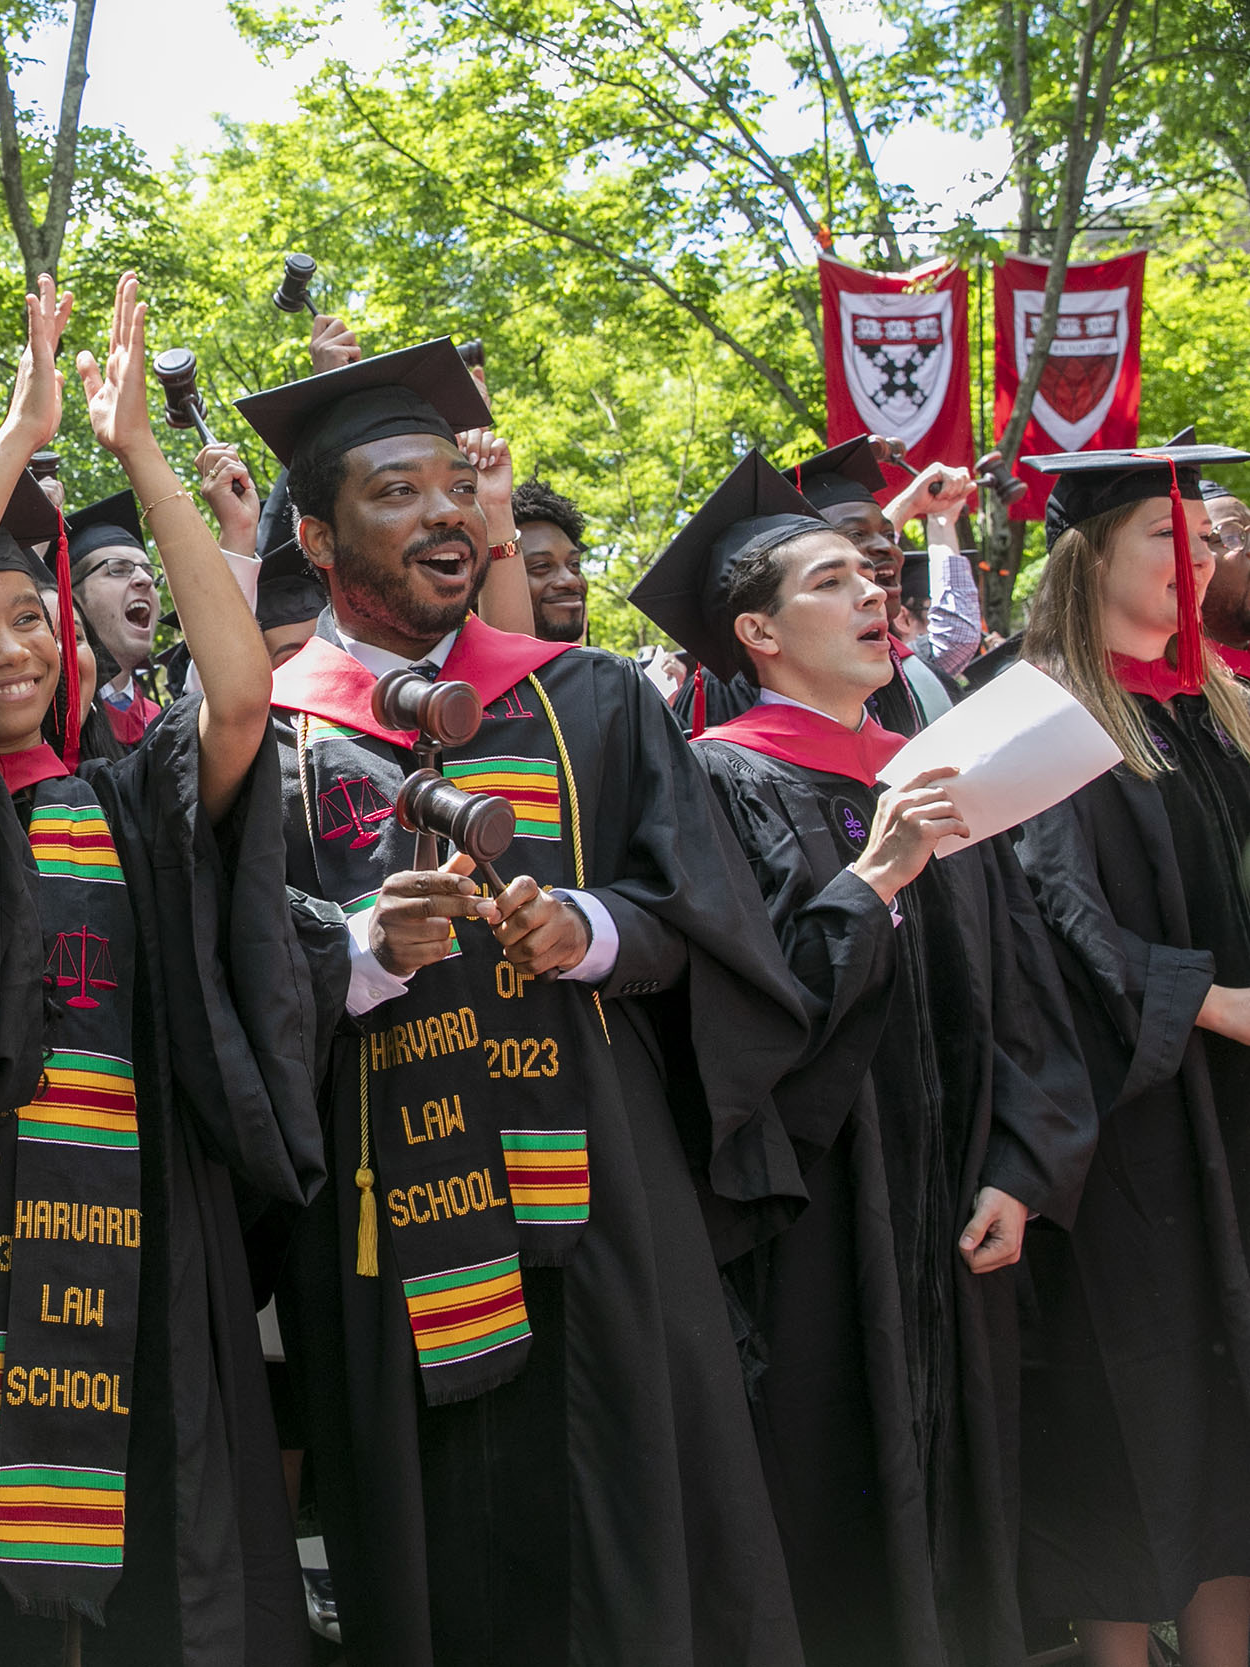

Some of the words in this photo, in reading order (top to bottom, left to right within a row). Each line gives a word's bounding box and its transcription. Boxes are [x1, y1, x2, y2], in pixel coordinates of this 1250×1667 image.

[370, 1007, 479, 1071] HARVARD
[484, 1038, 559, 1079] 2023
[401, 1095, 465, 1145] LAW
[387, 1168, 507, 1227] SCHOOL
[15, 1200, 142, 1249] HARVARD
[41, 1284, 104, 1327] LAW
[7, 1366, 130, 1415] SCHOOL
